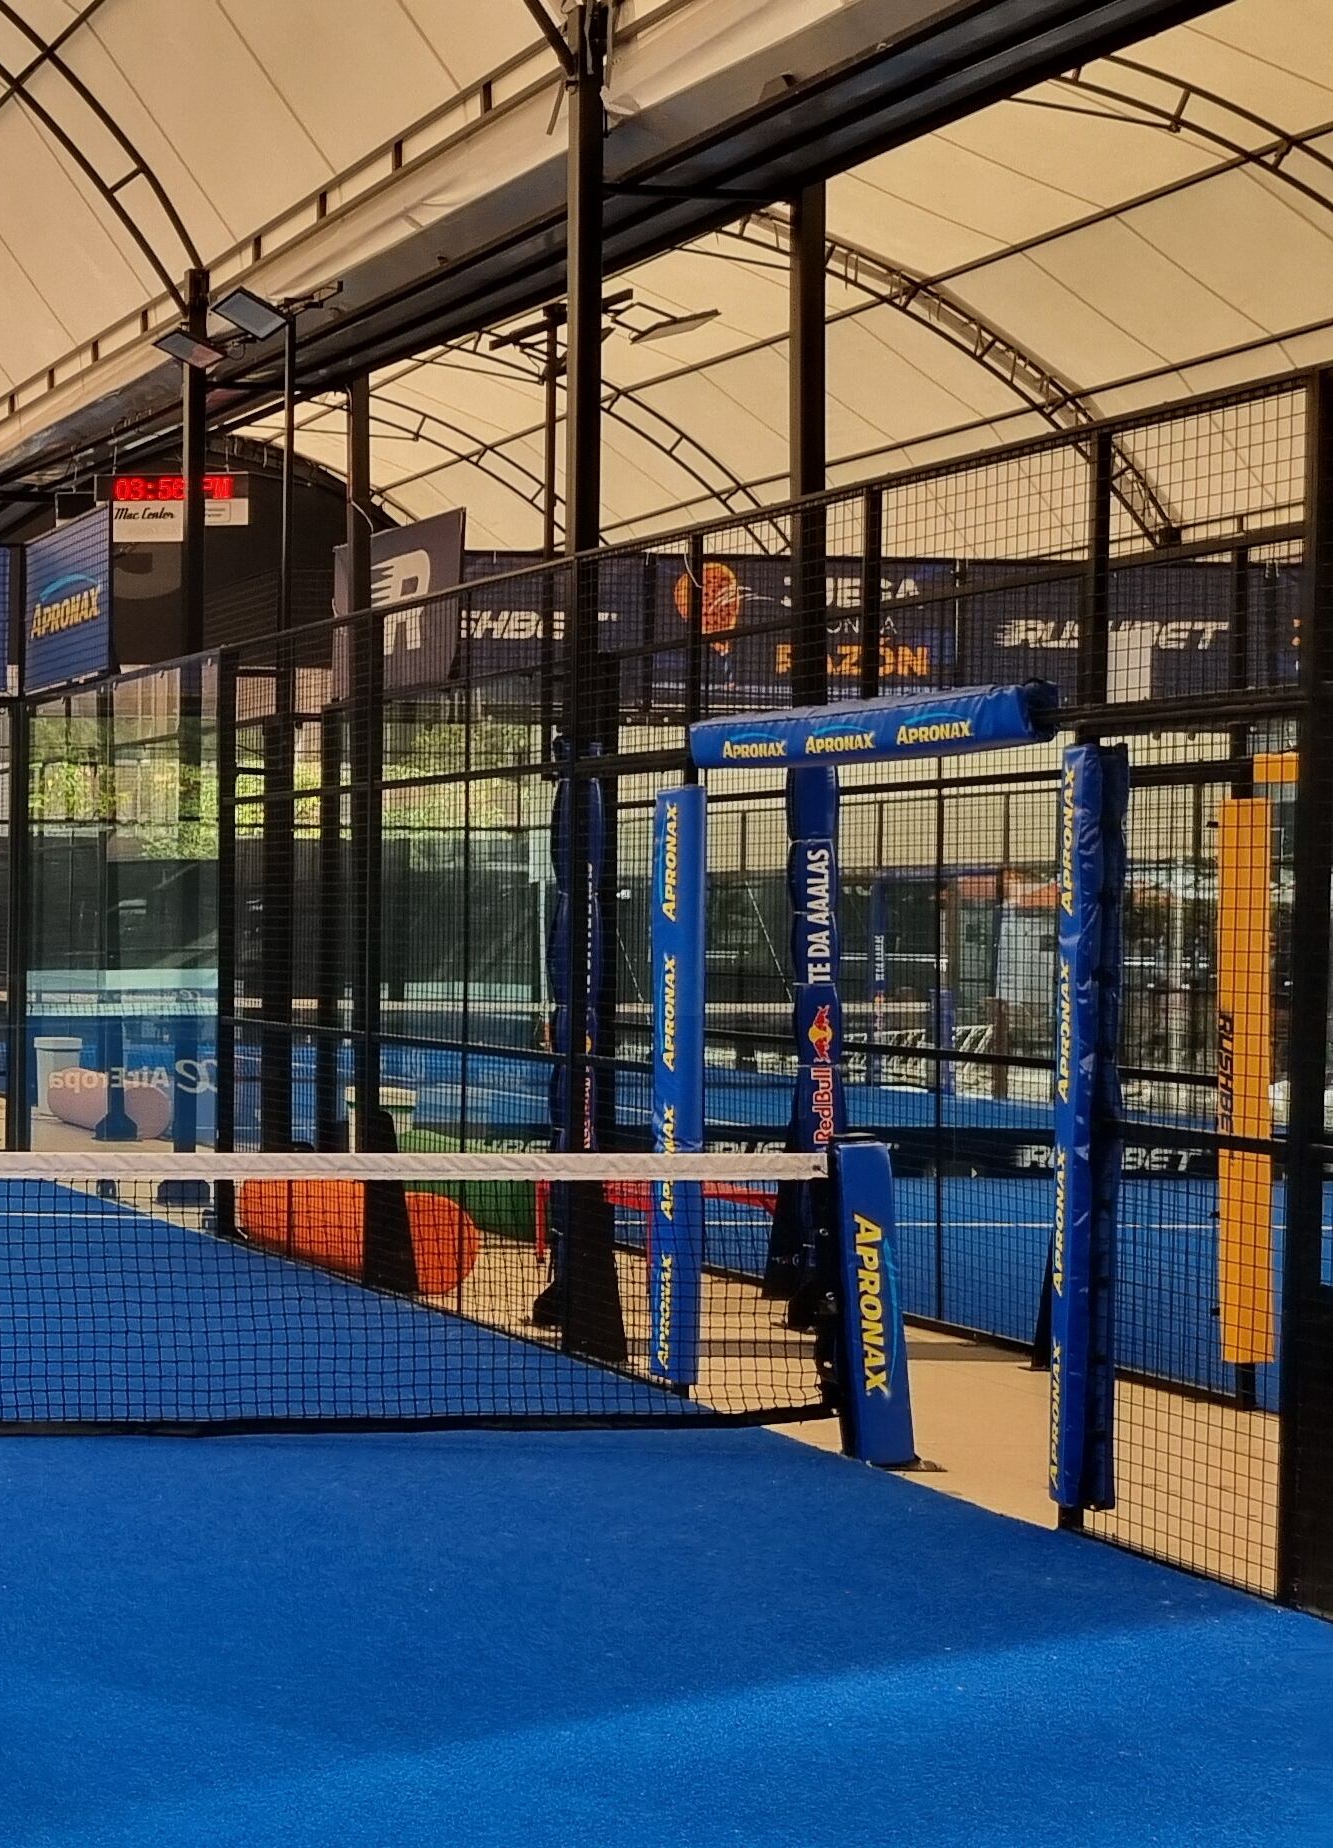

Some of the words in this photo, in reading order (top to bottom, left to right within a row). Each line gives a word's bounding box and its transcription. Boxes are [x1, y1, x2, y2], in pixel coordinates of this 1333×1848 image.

[30, 585, 101, 640] APRONAX
[775, 636, 930, 678] RZÓN
[722, 740, 787, 759] APRONAX
[805, 731, 875, 755] APRONAX
[896, 720, 973, 746] APRONAX
[661, 801, 678, 922] APRONAX
[806, 849, 830, 926] AAALAS
[1060, 765, 1076, 918] APRONAX
[807, 930, 831, 958] DA
[808, 963, 831, 985] TE
[661, 953, 677, 1072] APRONAX
[1056, 960, 1071, 1104] APRONAX
[1218, 1012, 1235, 1138] RUSHBE
[1051, 1147, 1066, 1297] APRONAX
[854, 1213, 890, 1398] APRONAX
[1048, 1339, 1061, 1490] APRONAX
